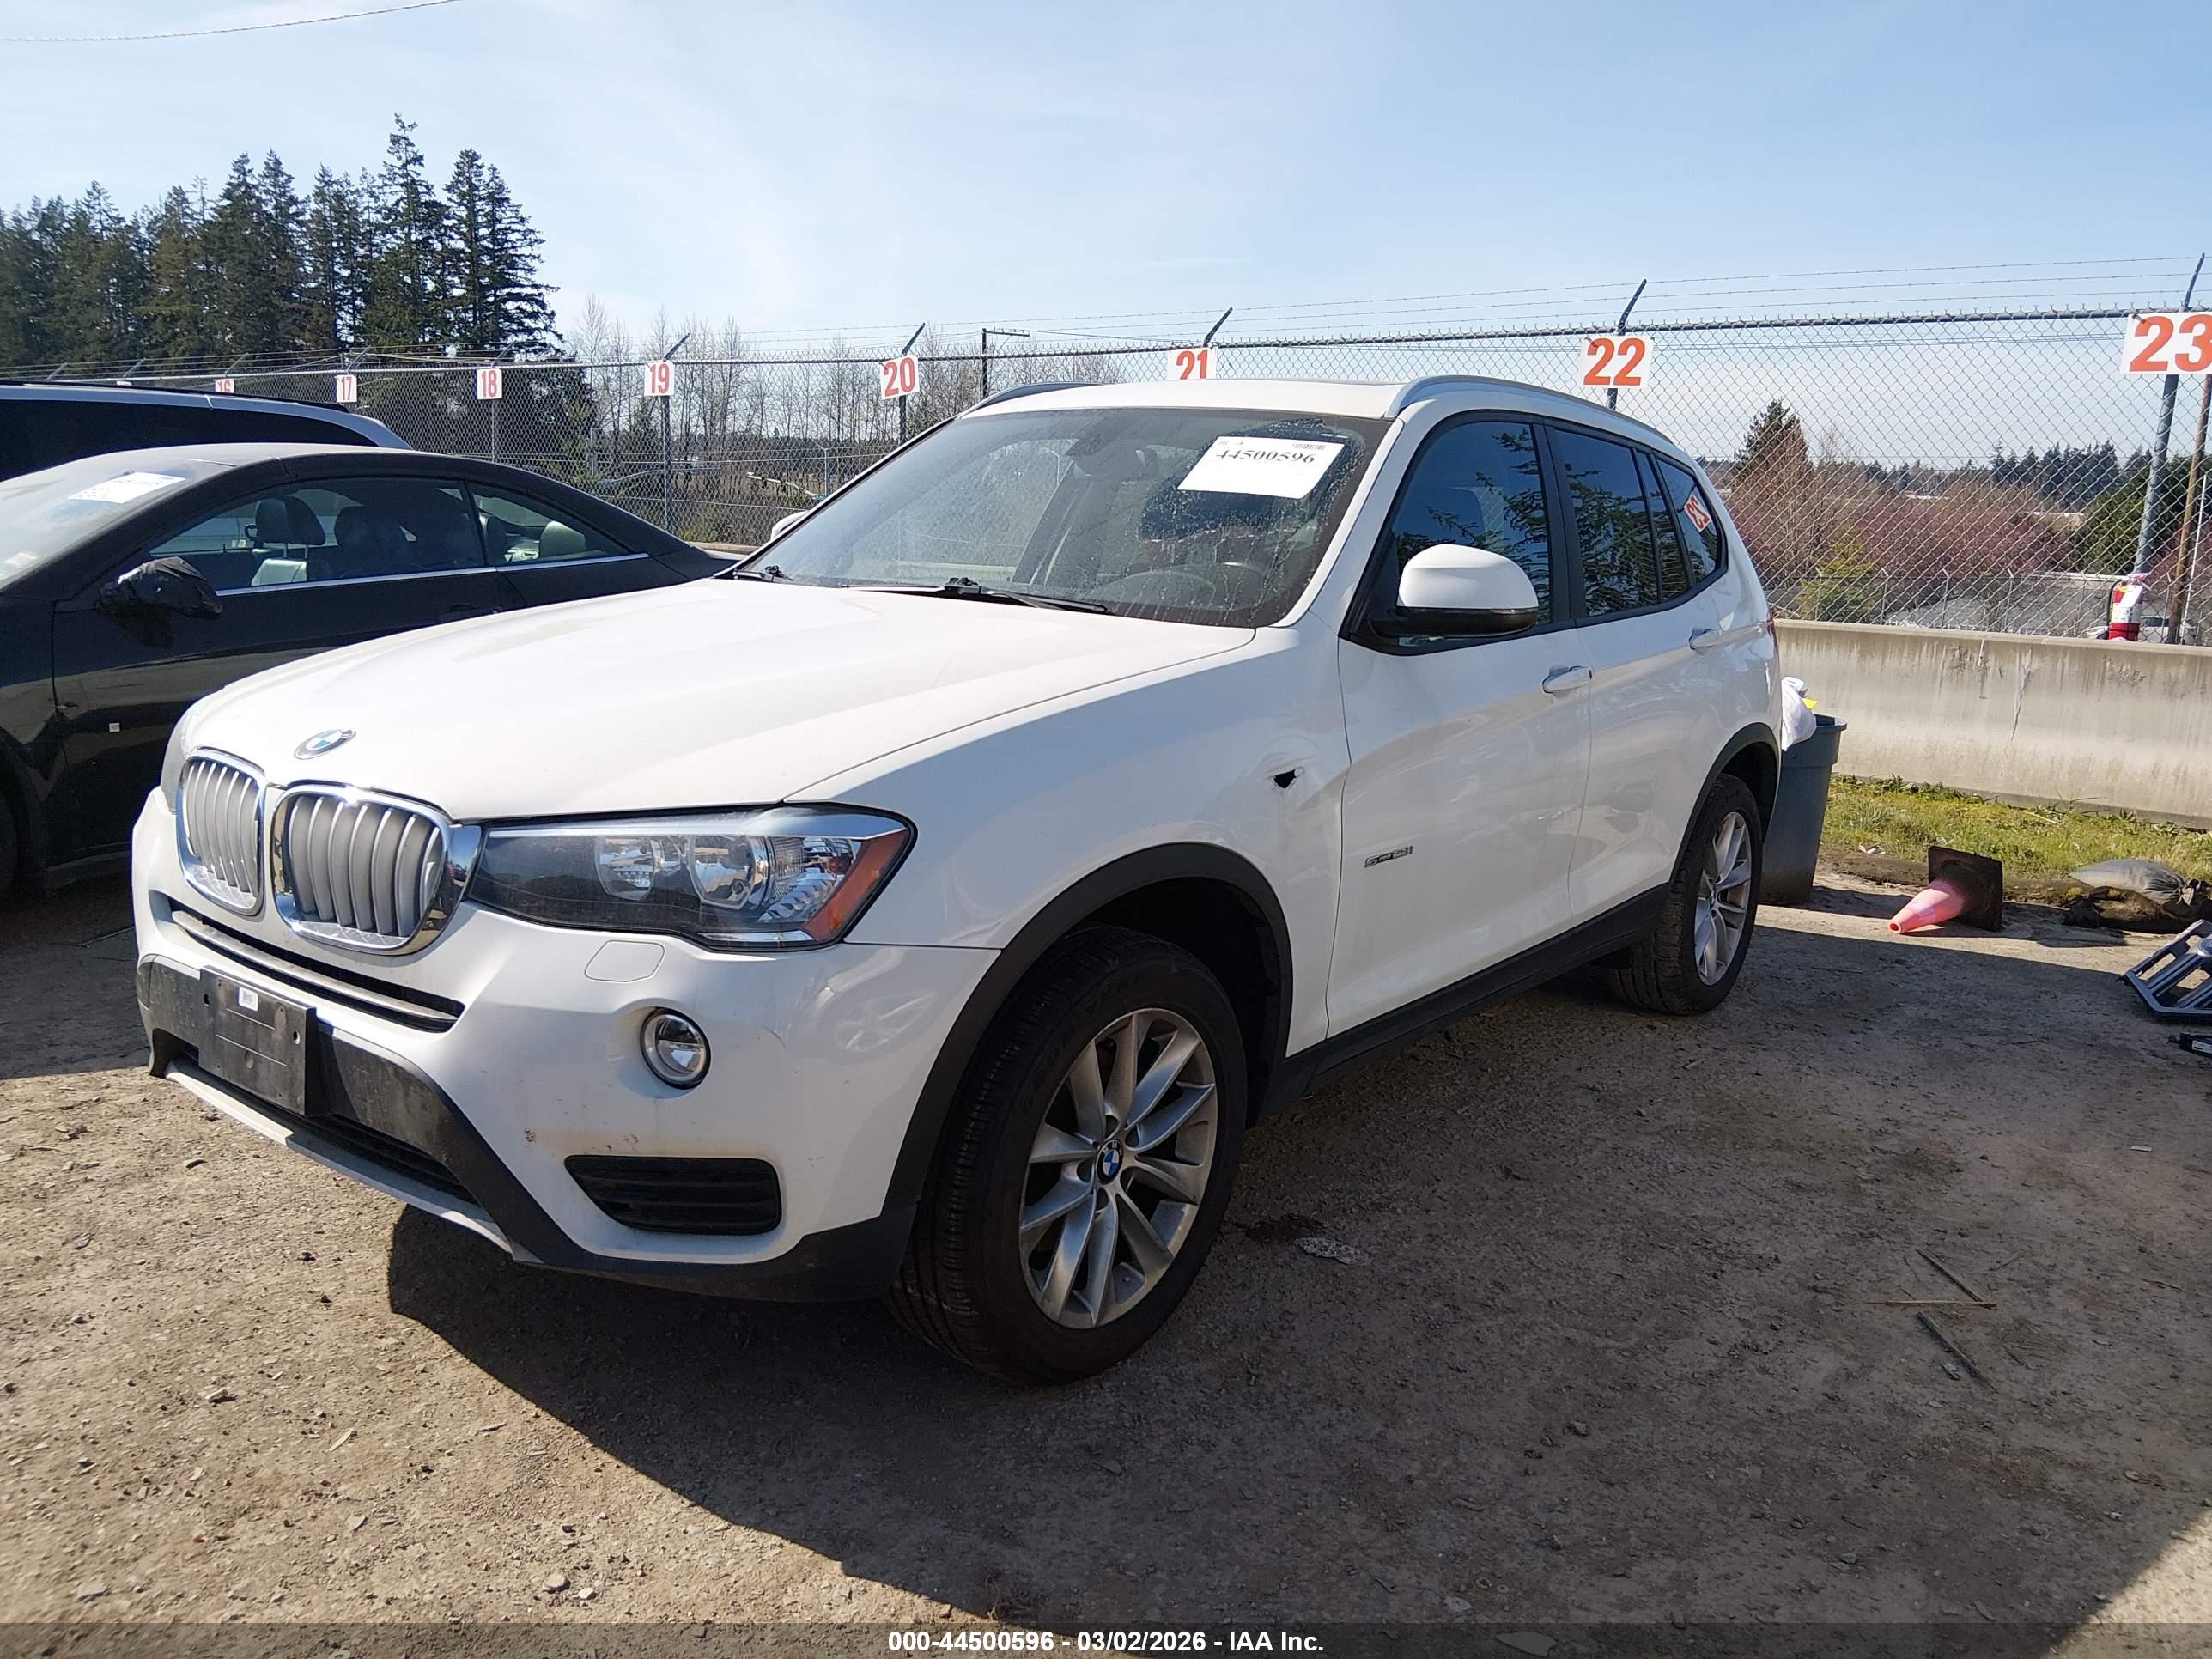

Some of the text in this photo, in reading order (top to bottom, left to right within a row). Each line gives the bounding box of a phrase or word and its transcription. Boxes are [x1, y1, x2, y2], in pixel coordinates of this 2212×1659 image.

[2130, 313, 2212, 372] 23
[883, 356, 916, 397] 20
[1176, 349, 1209, 380] 21
[1583, 337, 1646, 386] 22
[341, 376, 353, 401] 17
[481, 370, 497, 398] 18
[649, 363, 671, 395] 19
[1216, 449, 1316, 464] 44500596
